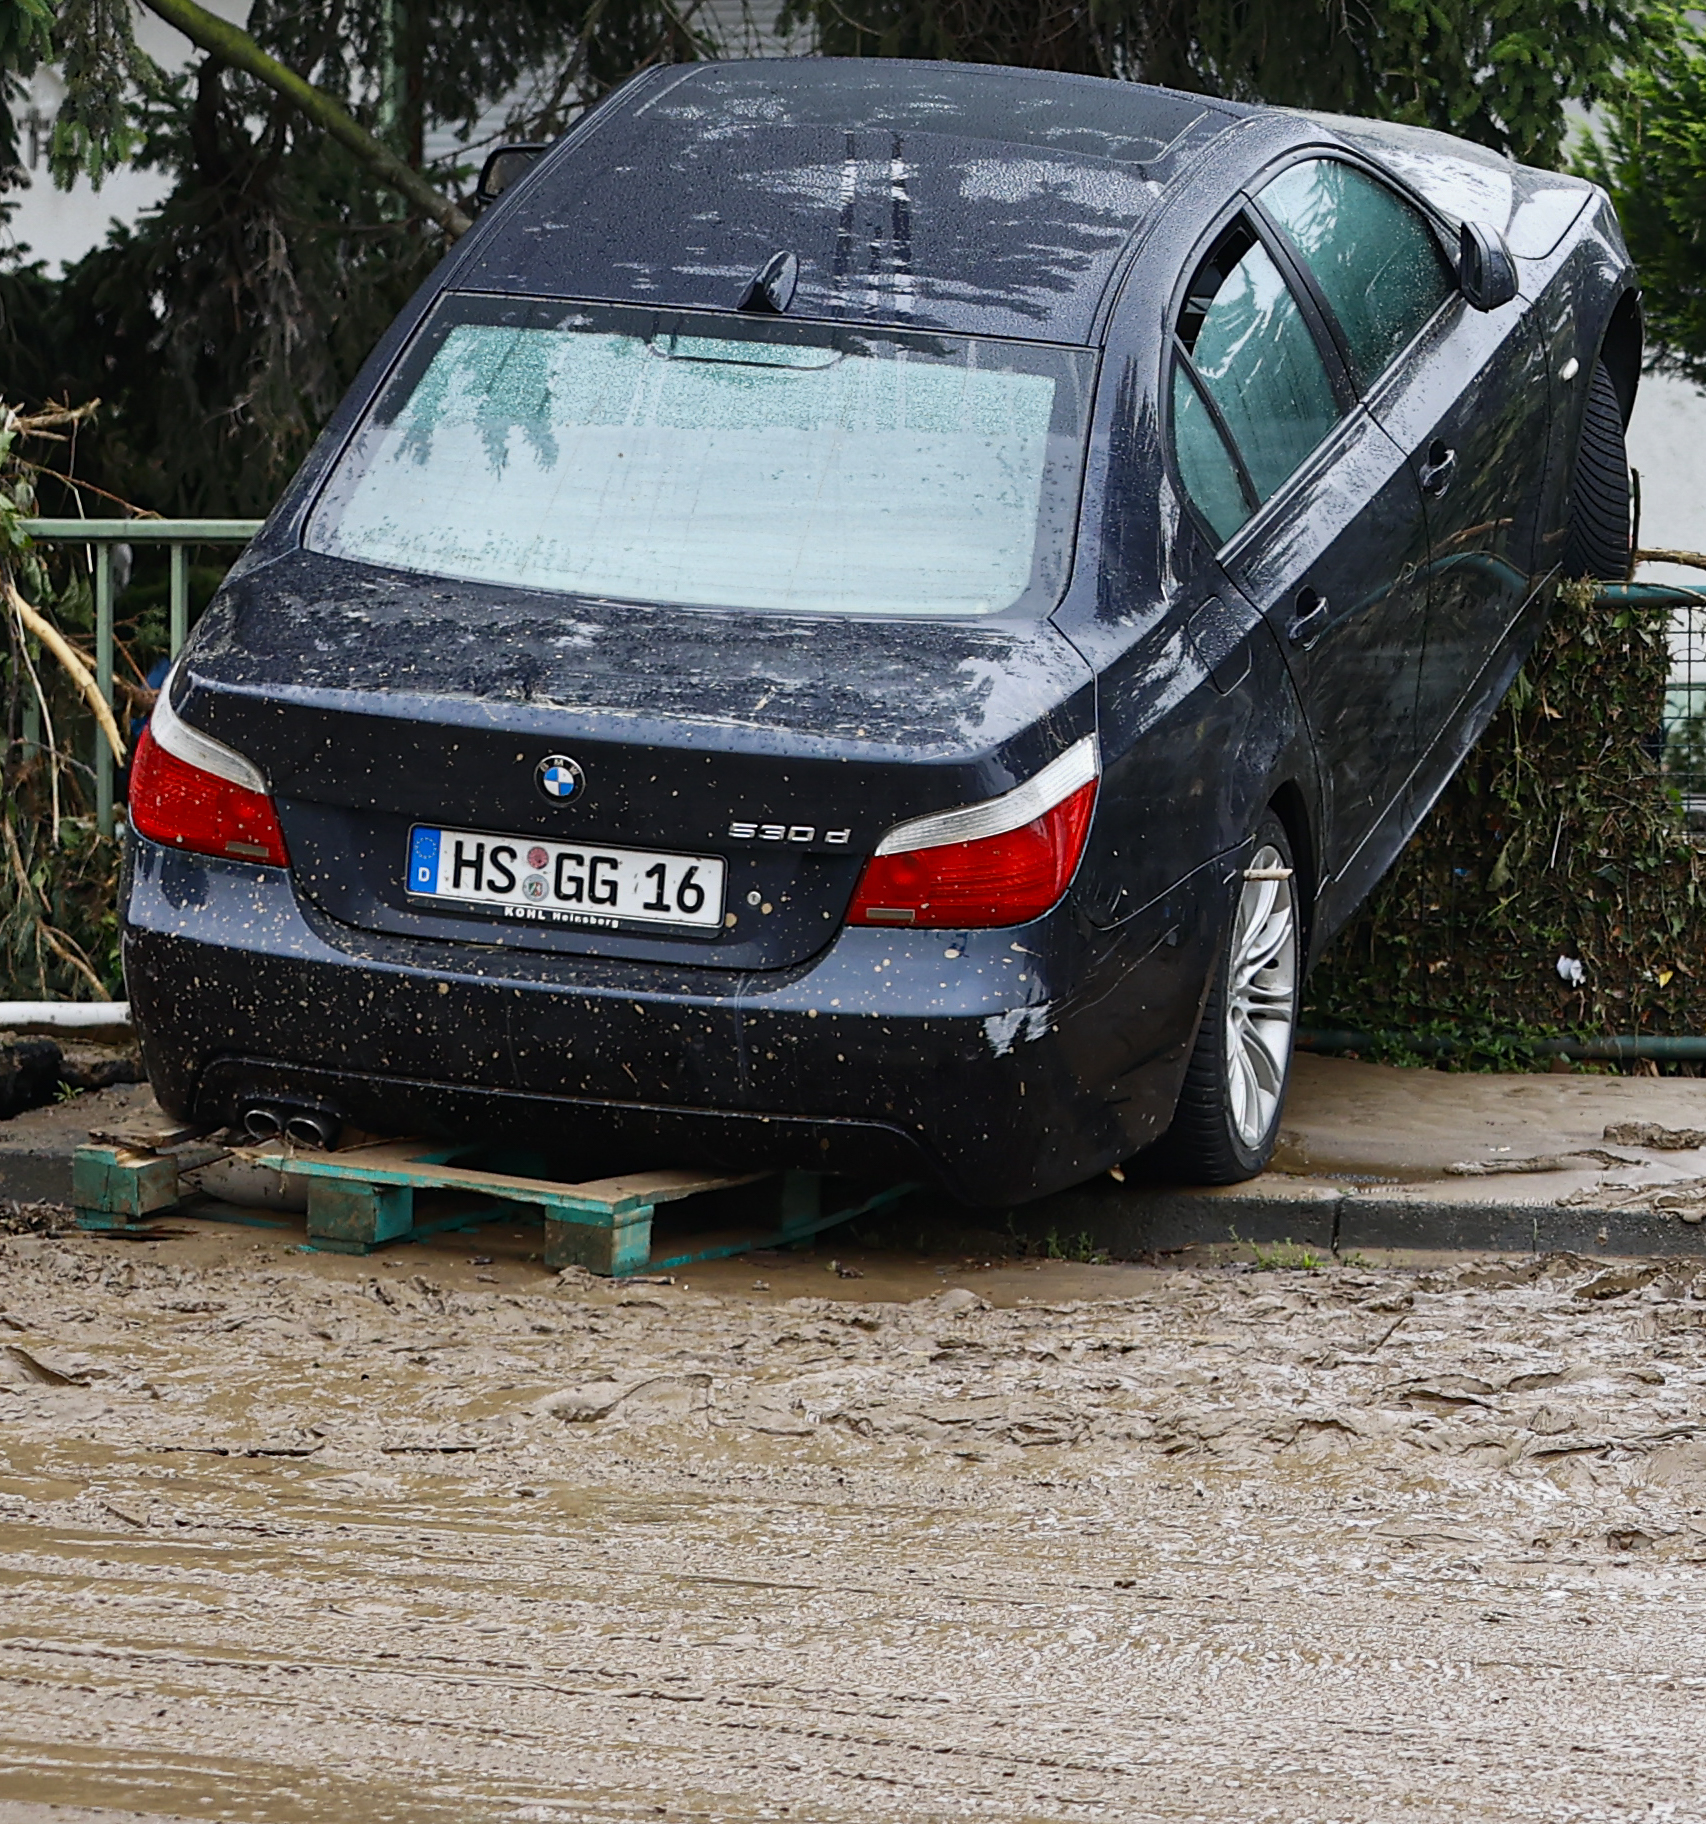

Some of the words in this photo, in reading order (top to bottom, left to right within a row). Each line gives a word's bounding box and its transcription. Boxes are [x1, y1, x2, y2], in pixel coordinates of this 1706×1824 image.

[728, 822, 816, 842] 530
[824, 828, 851, 844] d
[418, 866, 431, 882] D
[452, 840, 518, 894] HS
[554, 852, 619, 907] GG
[643, 862, 706, 914] 16
[503, 906, 546, 921] KOHL
[552, 912, 620, 929] Heinsberg
